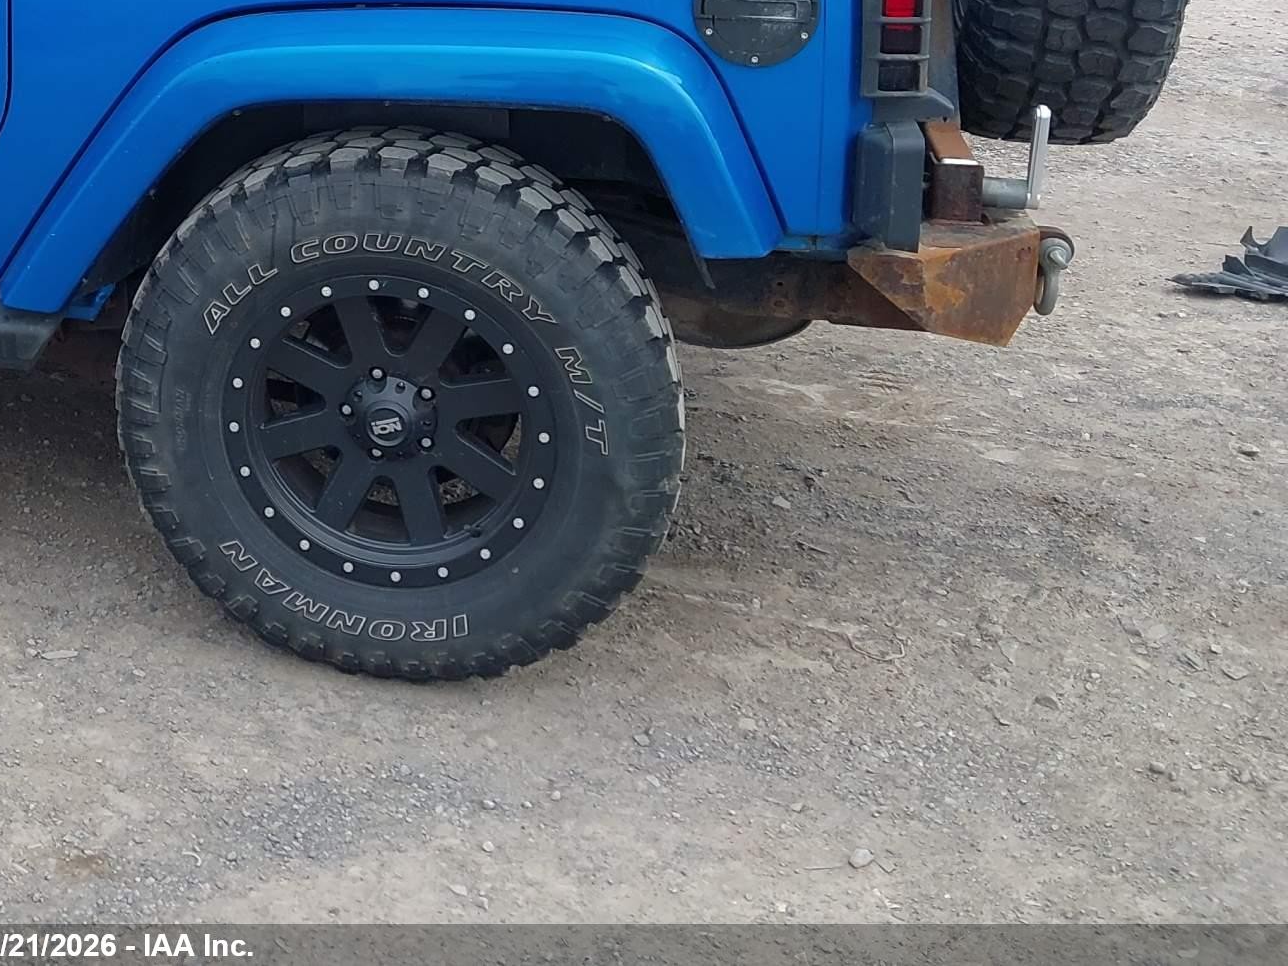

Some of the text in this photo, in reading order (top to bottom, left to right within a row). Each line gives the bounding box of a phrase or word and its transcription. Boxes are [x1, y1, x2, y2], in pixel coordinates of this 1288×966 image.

[201, 233, 610, 456] ALL COUNTRY M/T
[219, 539, 470, 643] IRONMAN
